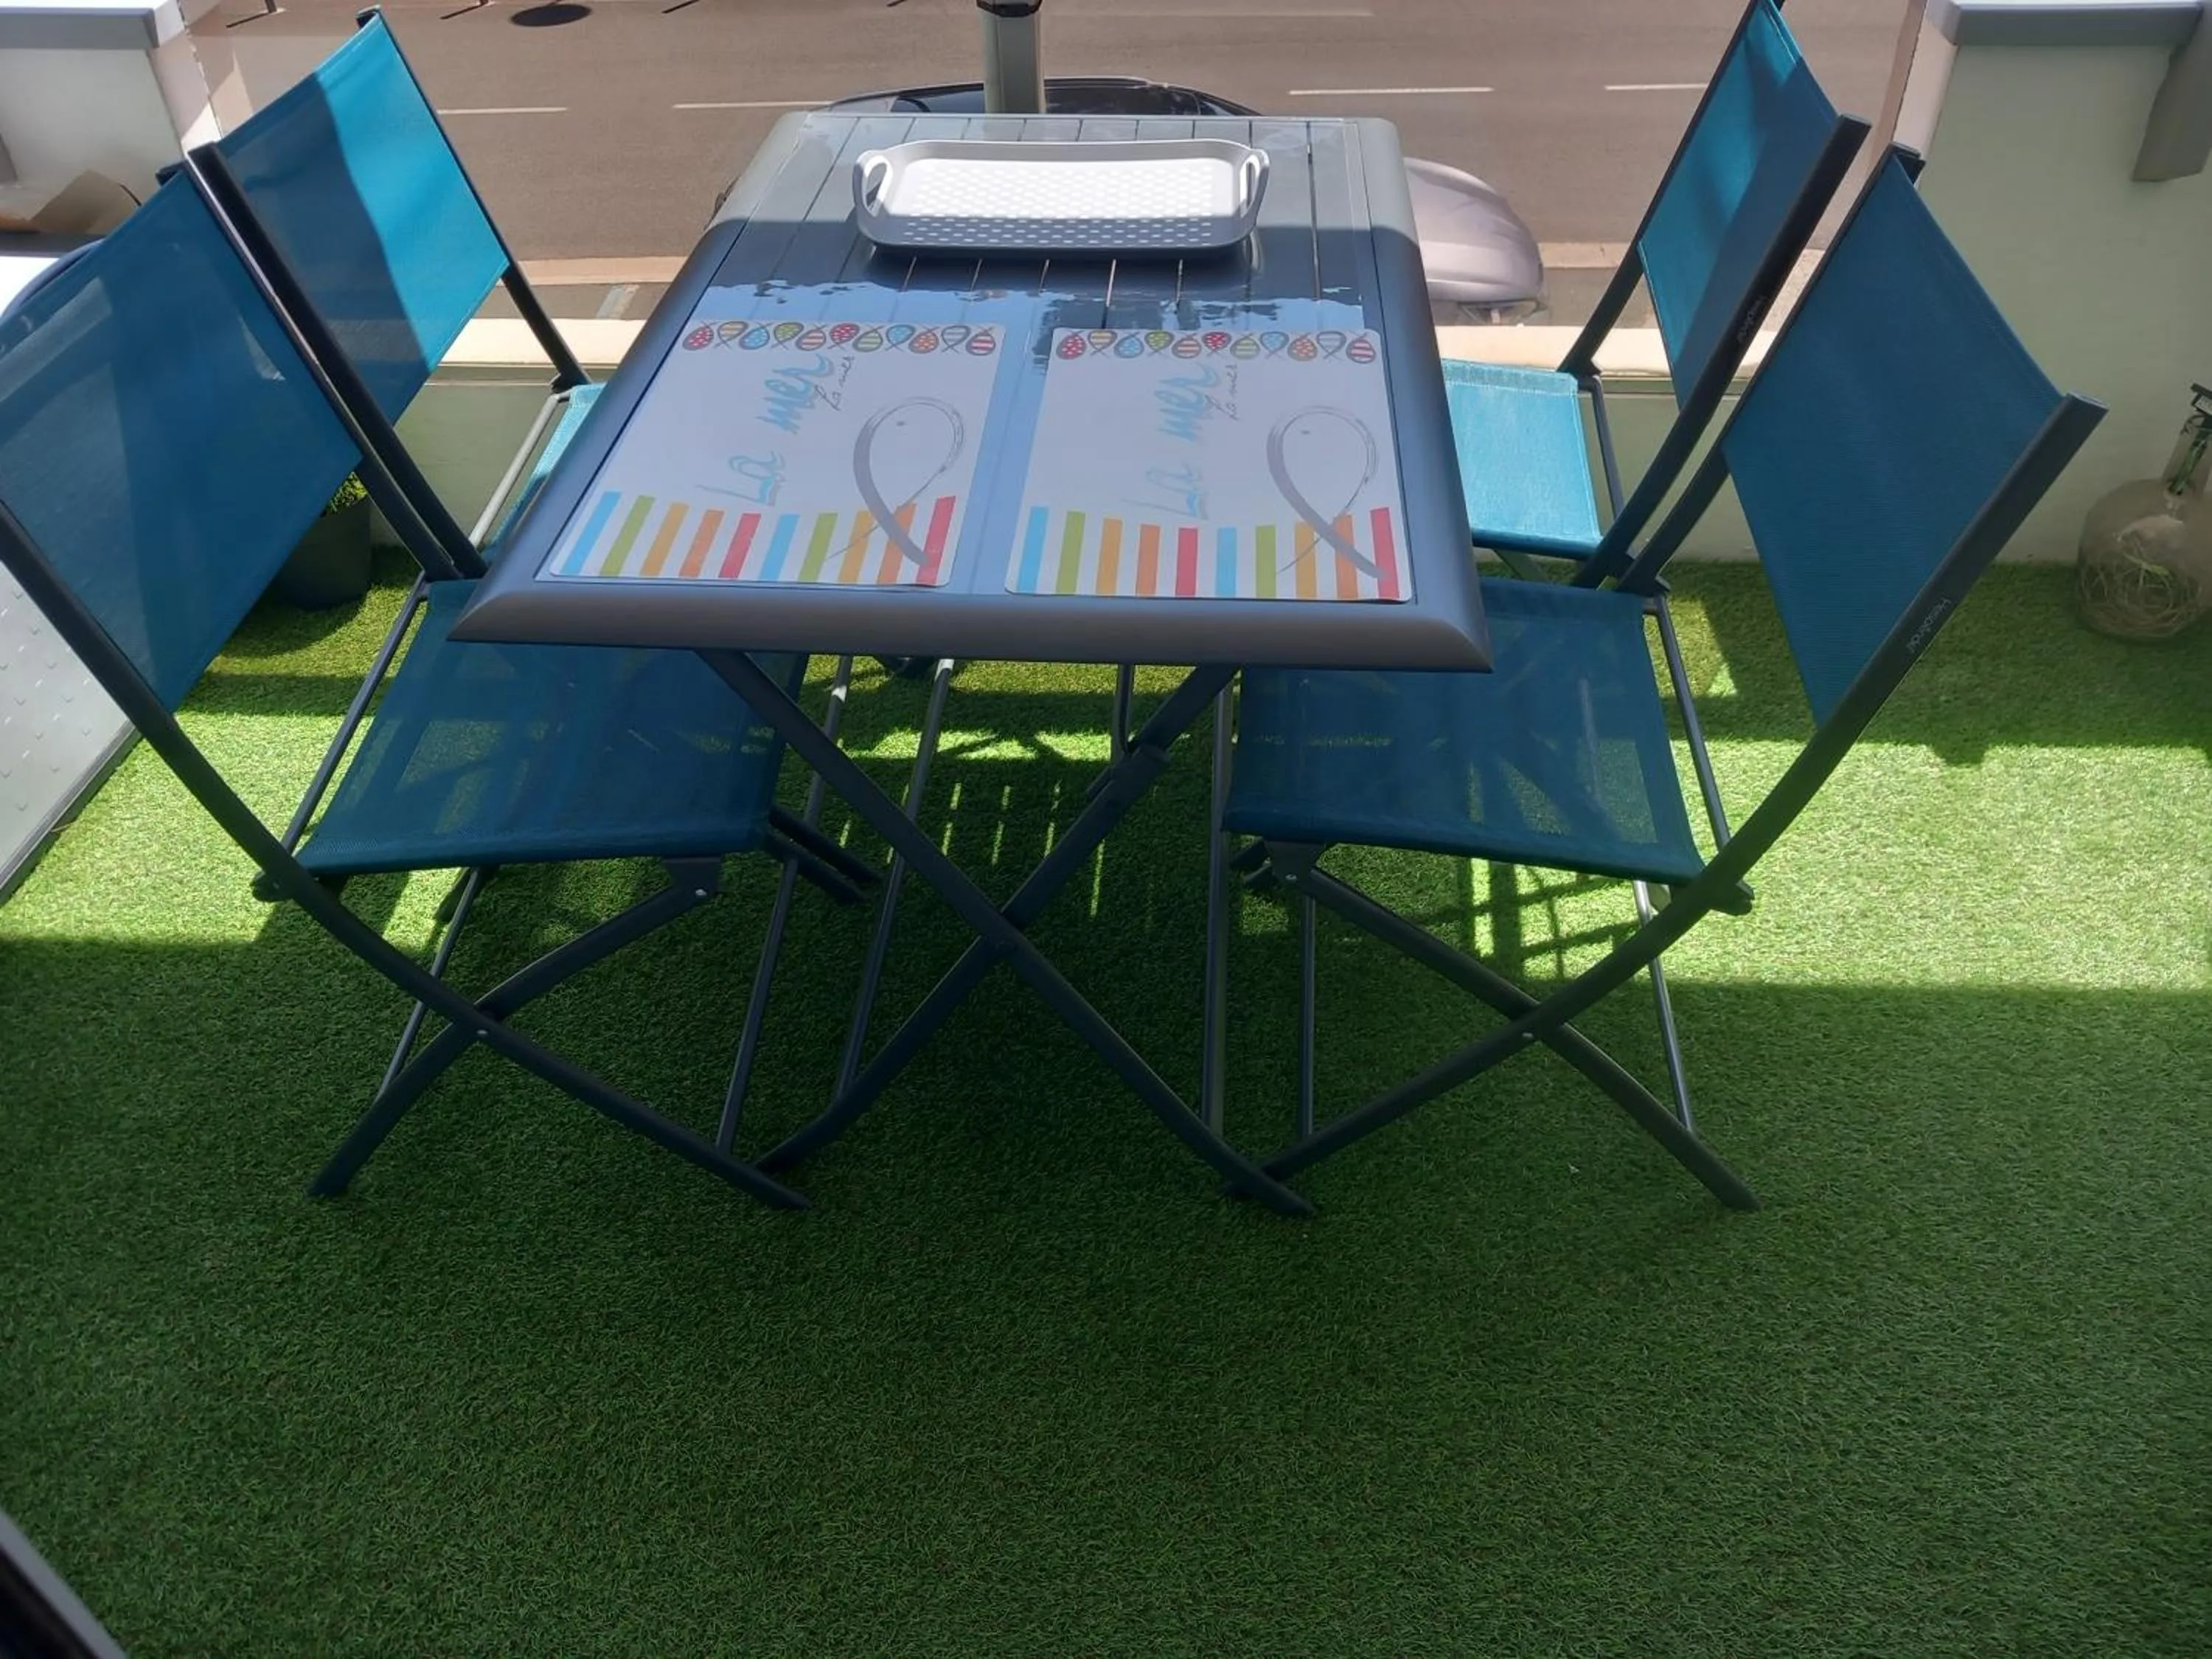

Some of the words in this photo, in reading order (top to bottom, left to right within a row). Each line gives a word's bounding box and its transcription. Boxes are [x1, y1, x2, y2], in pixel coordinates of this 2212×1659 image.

[695, 451, 786, 507] La
[754, 353, 835, 435] mer
[1154, 361, 1220, 442] mer
[1120, 462, 1208, 520] La
